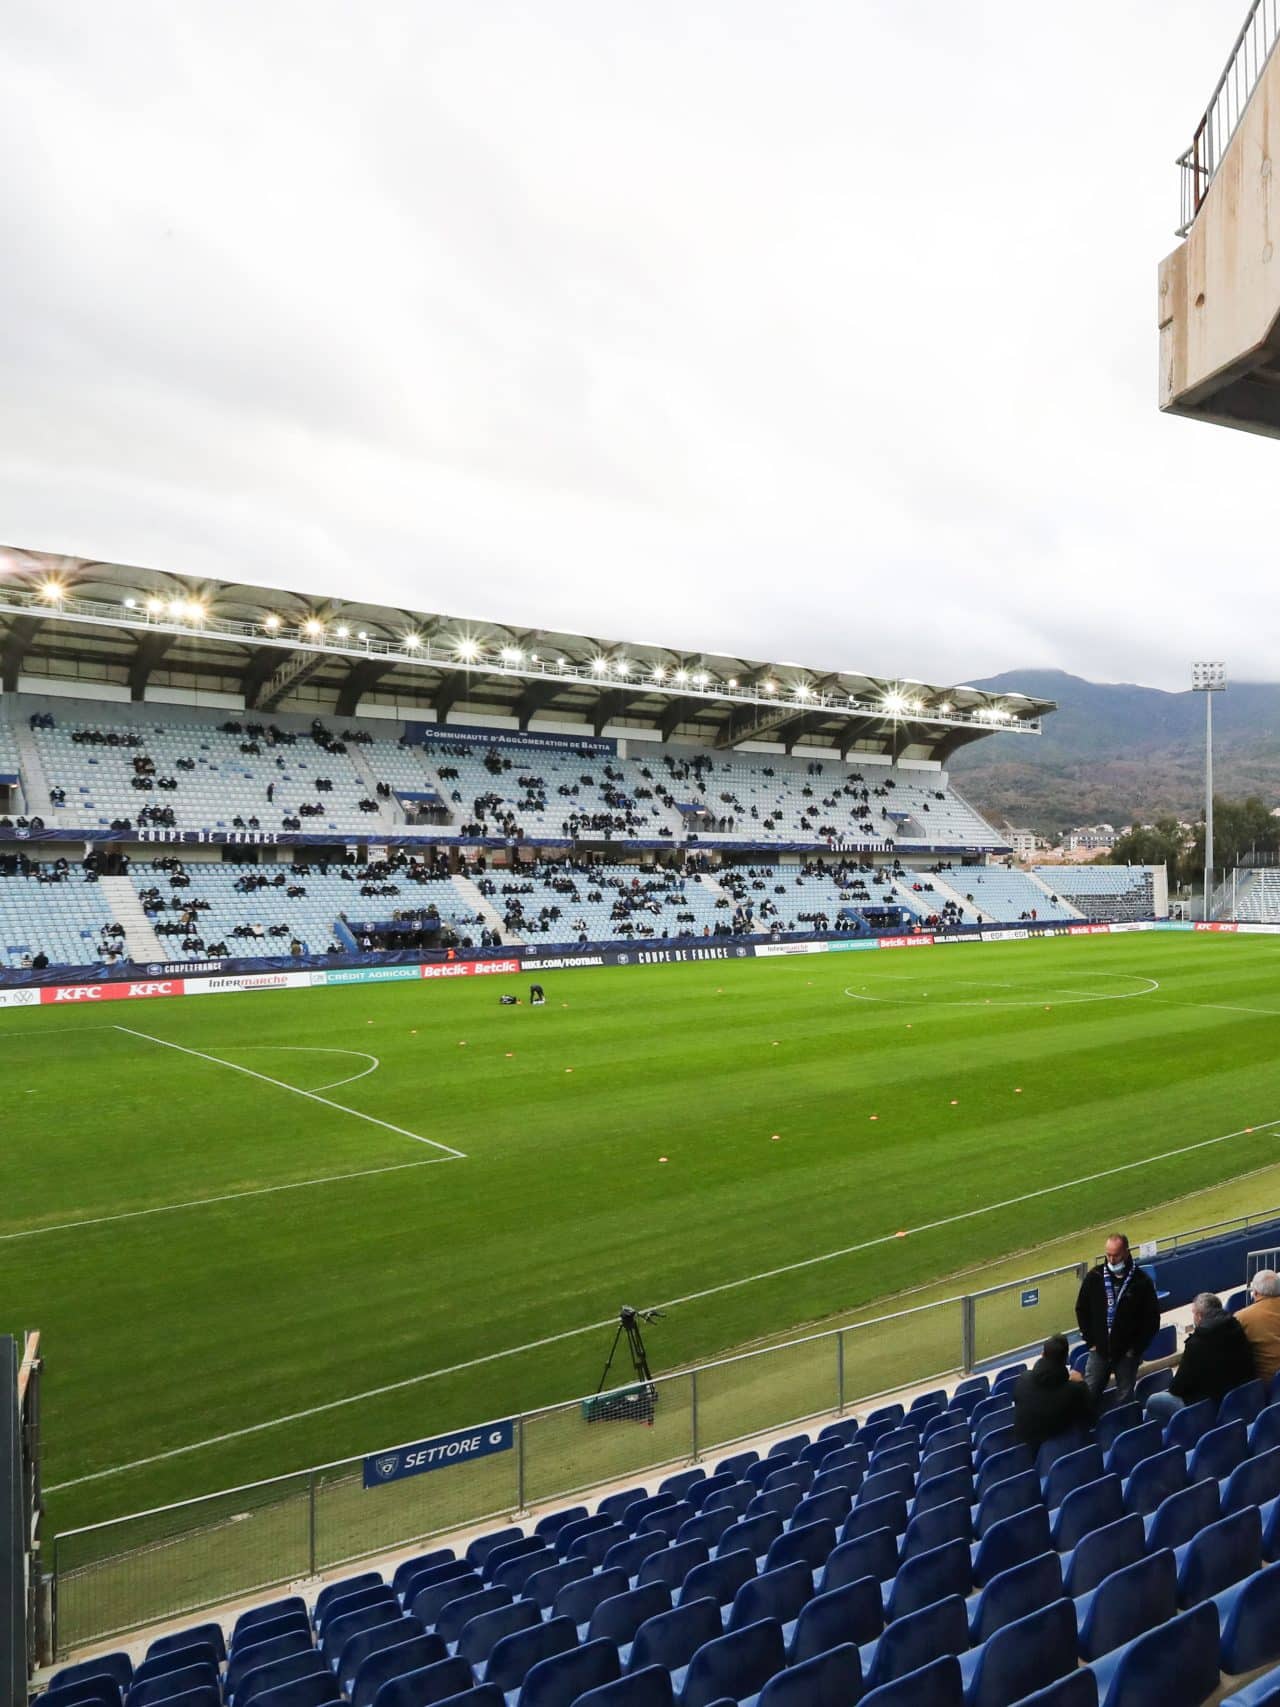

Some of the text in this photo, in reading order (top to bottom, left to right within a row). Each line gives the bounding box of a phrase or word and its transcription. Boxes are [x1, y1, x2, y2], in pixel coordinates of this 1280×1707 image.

[138, 830, 279, 844] COUPE DE FRANCE
[638, 947, 728, 964] COUPE DE FRANCE
[424, 960, 516, 977] Betclic Betclic
[55, 982, 172, 1001] KFC KFC
[404, 1431, 502, 1468] SETTORE G
